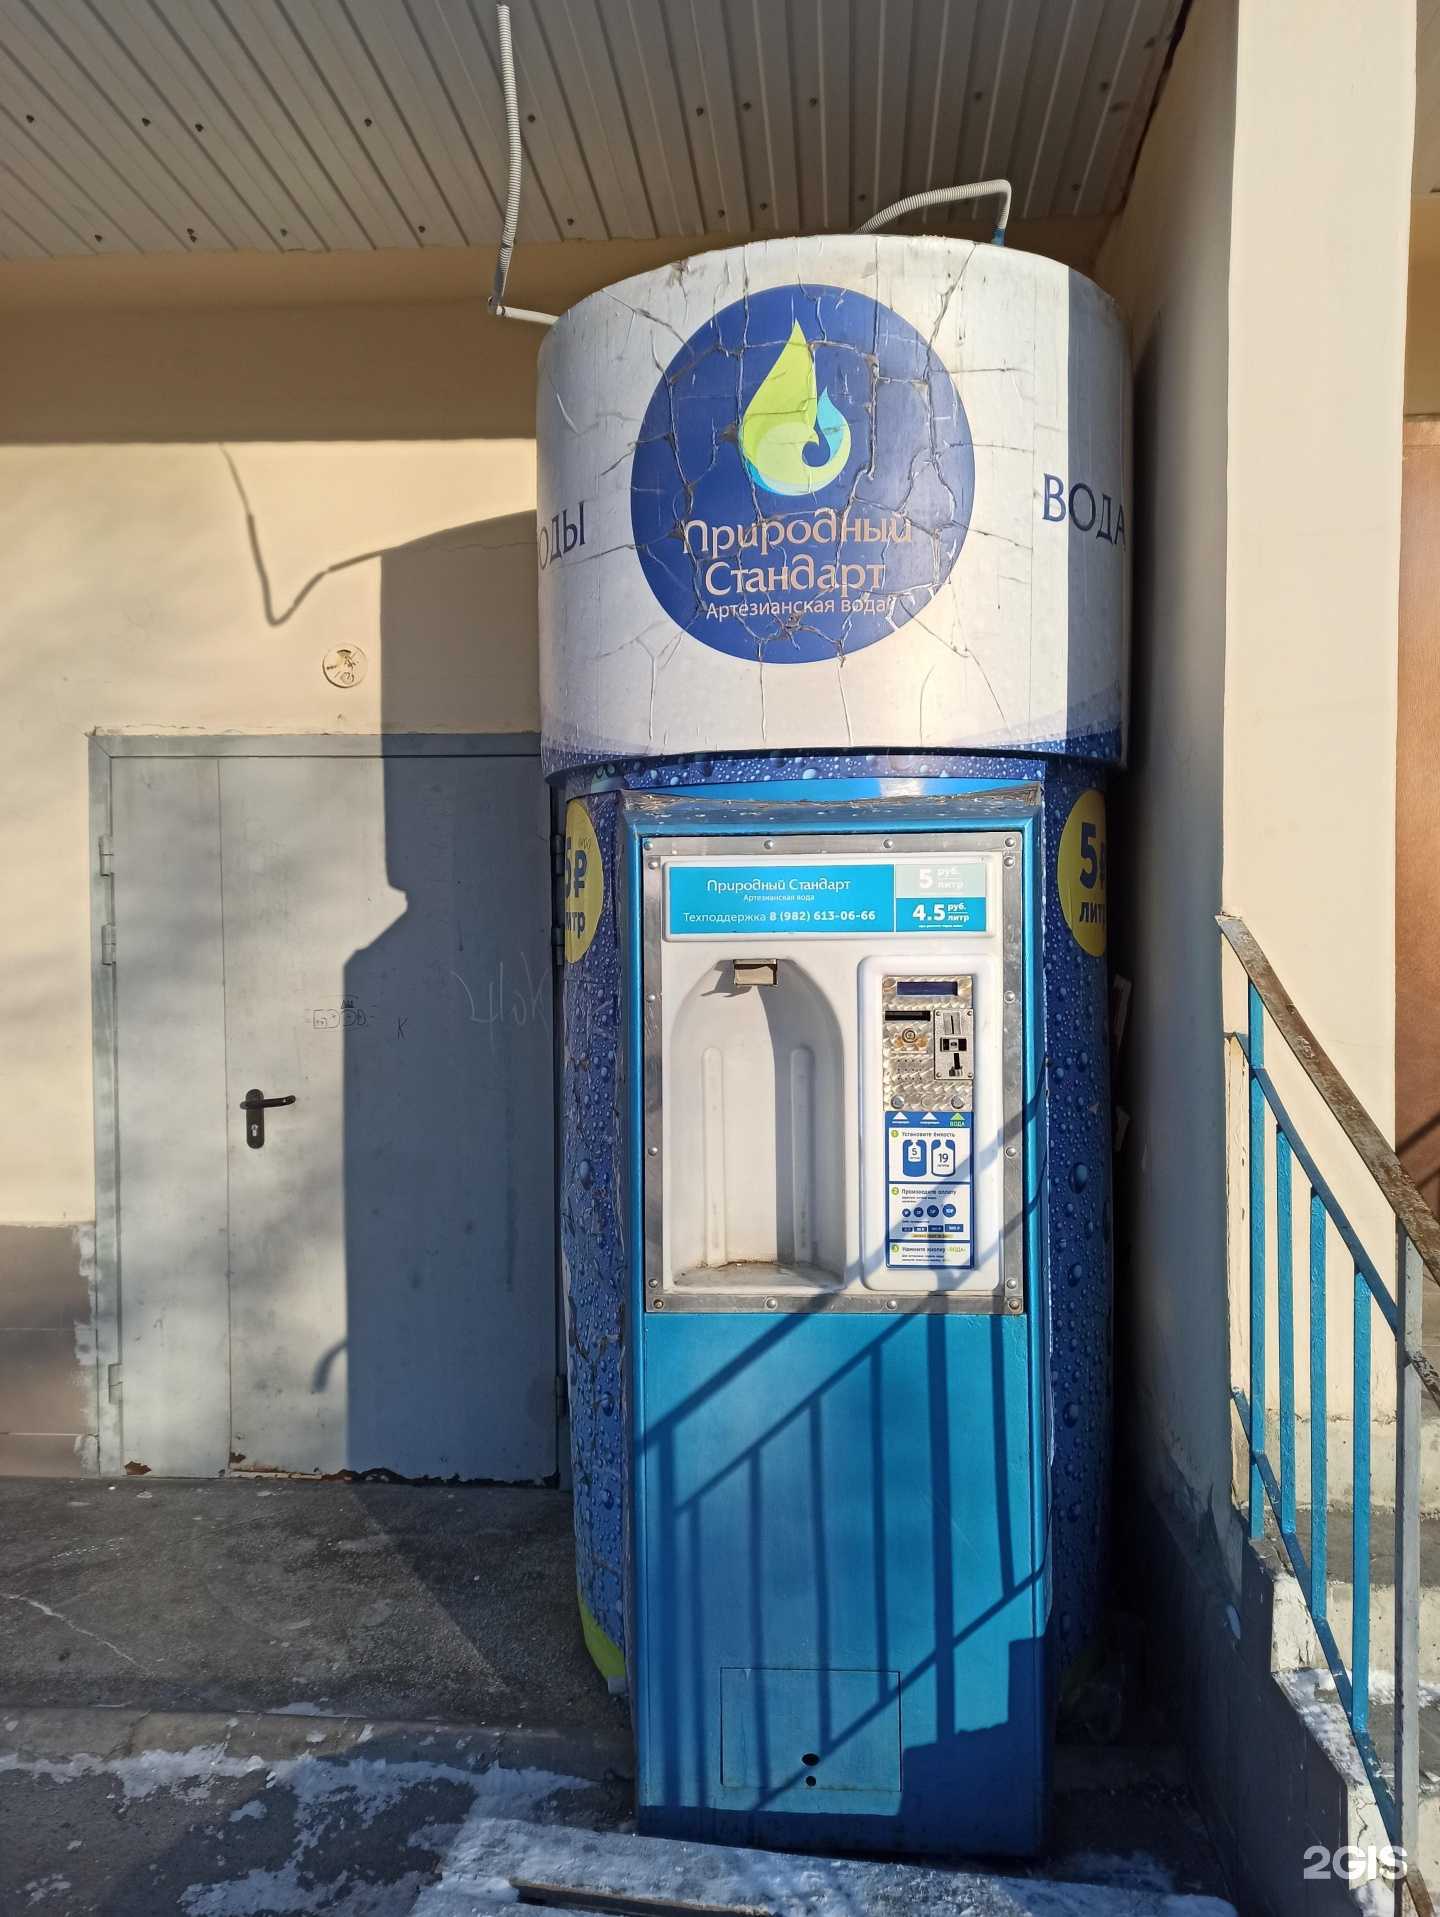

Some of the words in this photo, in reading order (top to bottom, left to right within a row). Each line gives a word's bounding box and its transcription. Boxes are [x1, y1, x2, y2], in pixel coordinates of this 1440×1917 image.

[1042, 473, 1126, 552] ВОДА
[683, 507, 913, 559] Природный
[705, 554, 888, 598] Стандарт
[706, 599, 835, 621] Артезианская
[841, 598, 886, 617] вода
[706, 879, 786, 894] Природный
[789, 878, 851, 893] Стандарт
[919, 868, 932, 888] 5
[683, 912, 766, 923] Техподдержка
[769, 911, 777, 921] 8
[780, 911, 811, 922] (982)
[813, 911, 876, 921] 613-06-66
[912, 903, 946, 921] 4.5
[948, 902, 967, 912] руб.
[947, 914, 970, 923] литр
[912, 1148, 918, 1156] 5
[938, 1153, 949, 1163] 19
